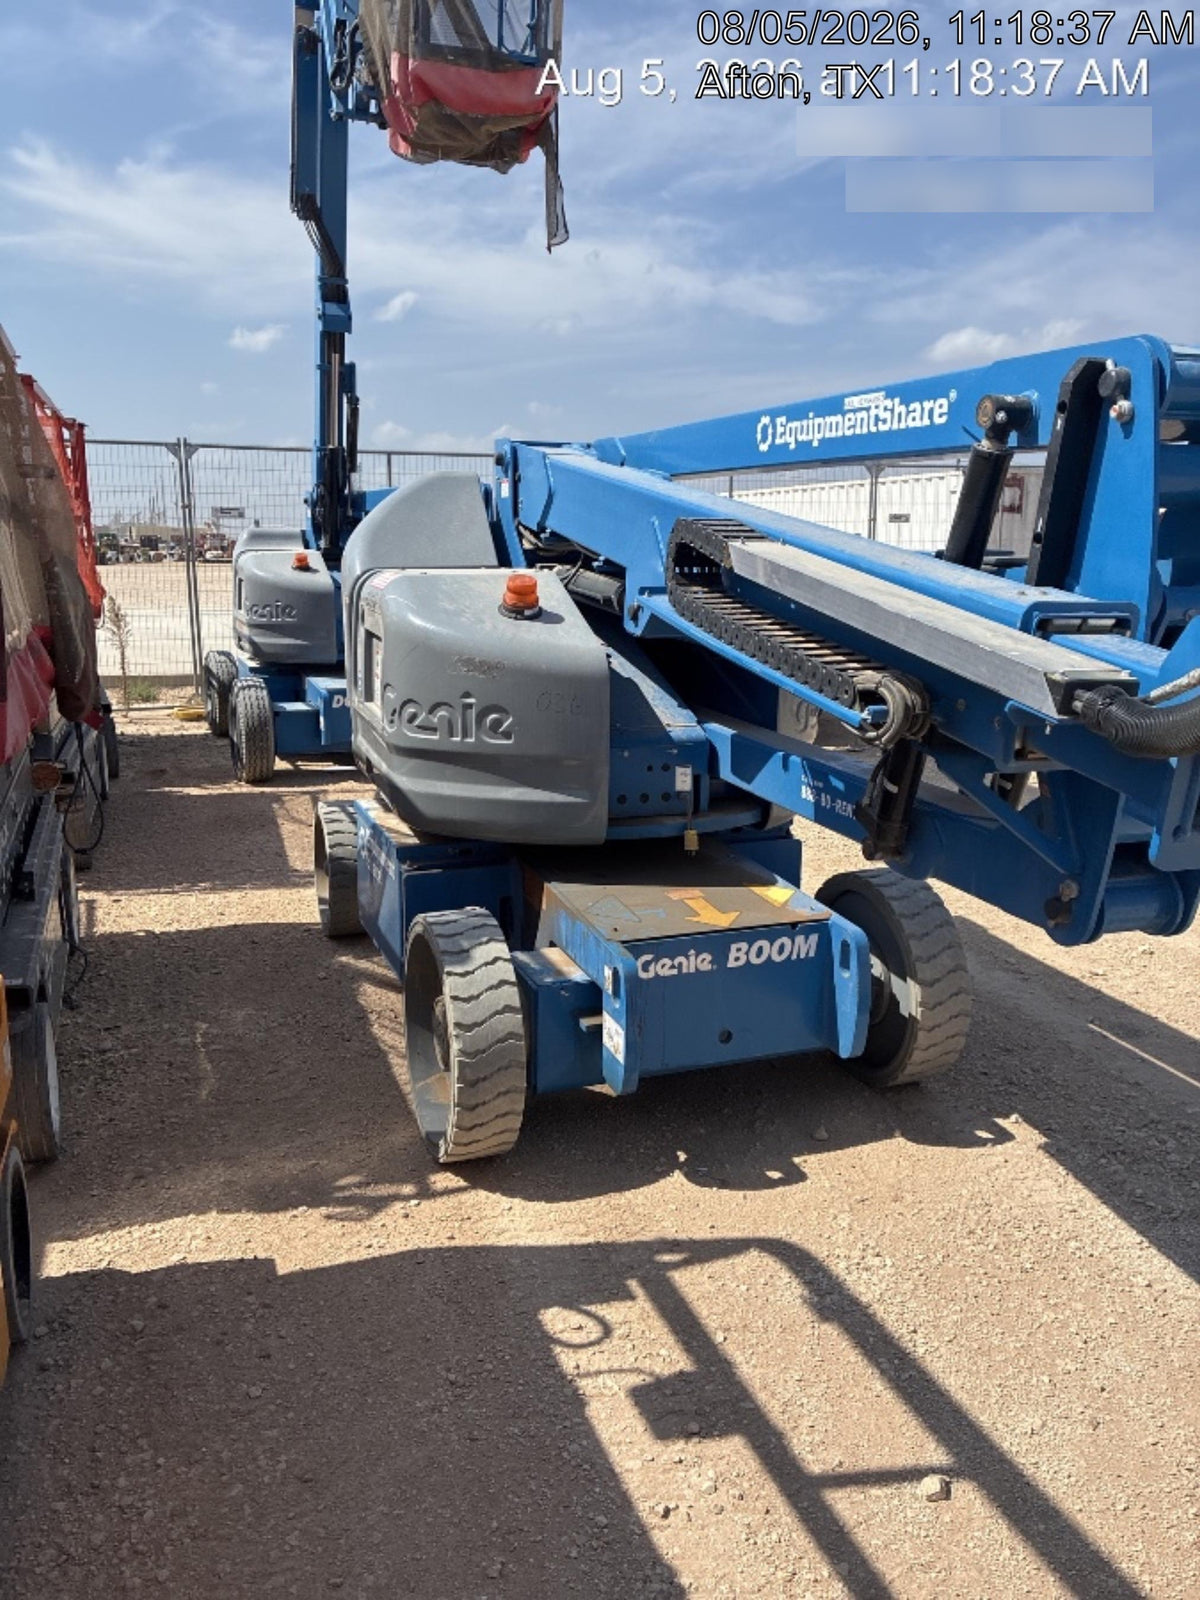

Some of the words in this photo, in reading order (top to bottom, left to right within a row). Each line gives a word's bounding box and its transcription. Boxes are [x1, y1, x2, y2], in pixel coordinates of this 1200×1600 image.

[775, 397, 949, 450] EquipmentShare
[637, 949, 713, 979] Genie
[727, 933, 819, 968] BOOM
